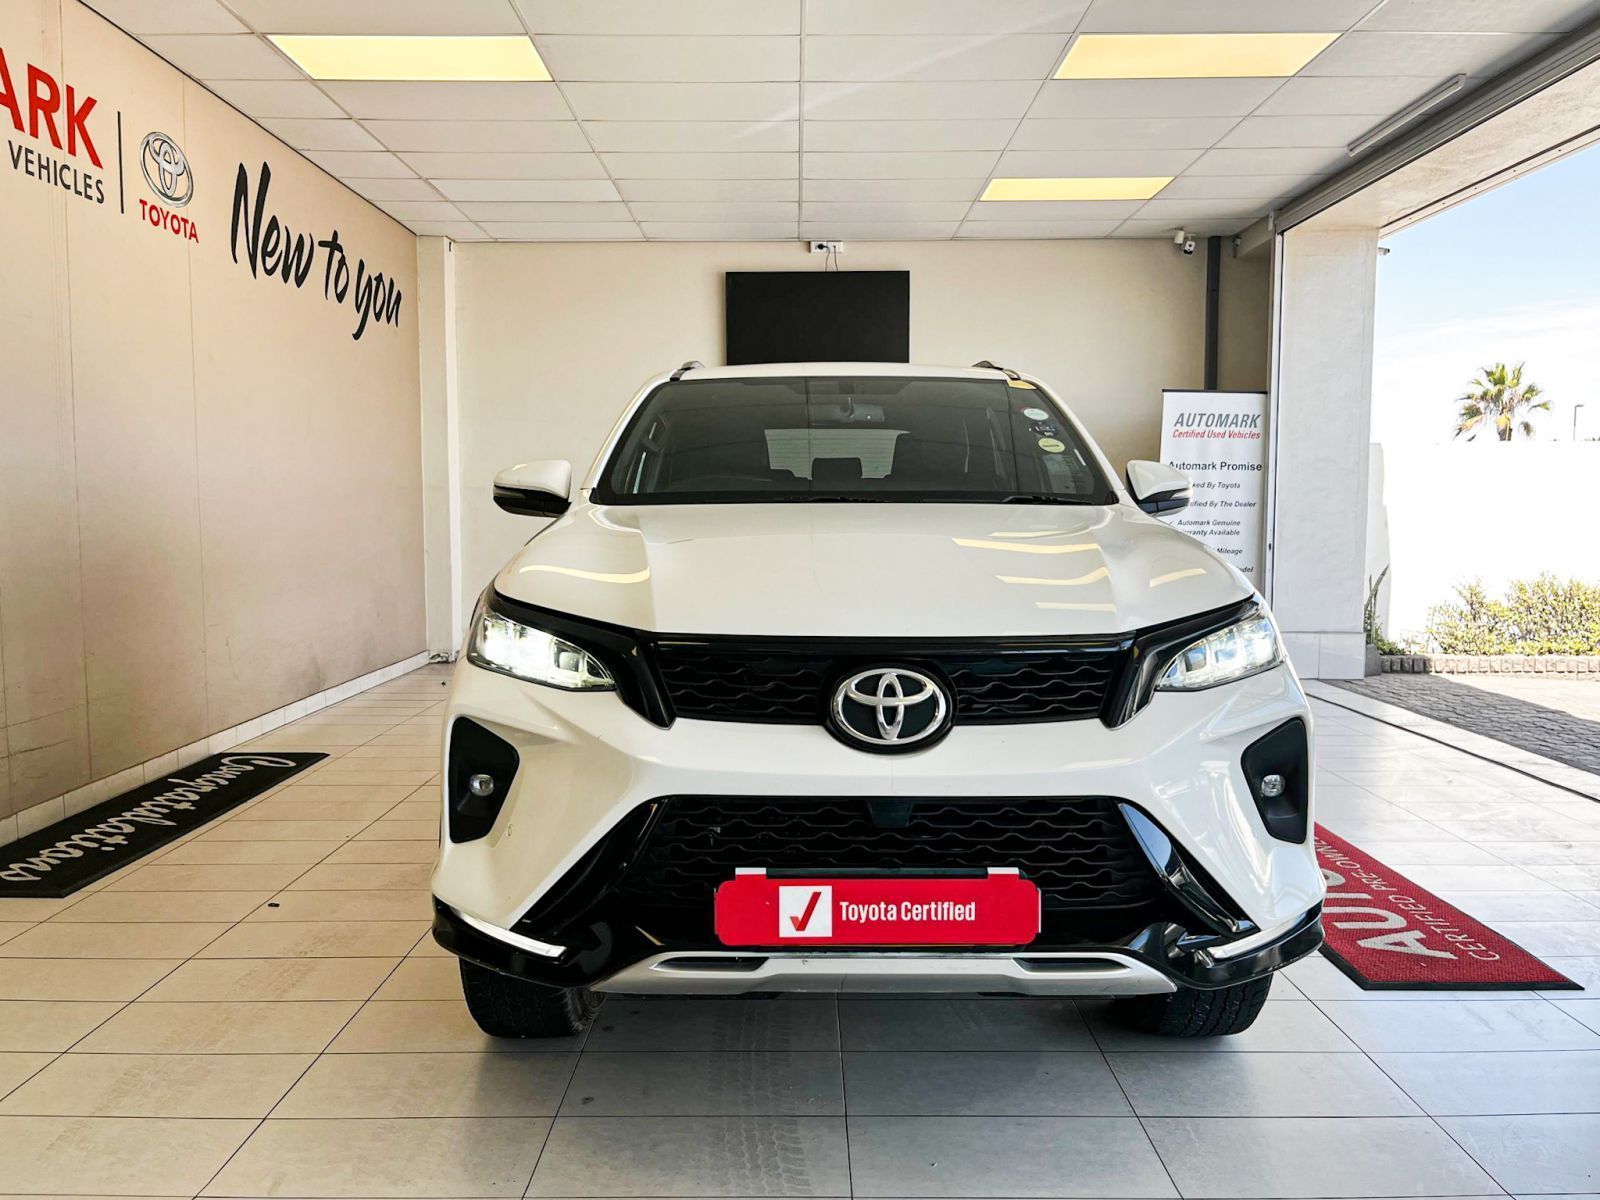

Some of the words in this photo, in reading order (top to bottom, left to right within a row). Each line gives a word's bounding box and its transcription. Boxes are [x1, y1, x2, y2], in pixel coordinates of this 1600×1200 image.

[8, 140, 105, 204] VEHICLES
[139, 199, 199, 244] TOYOTA
[230, 161, 314, 288] New
[318, 229, 350, 303] to
[351, 258, 402, 340] you
[1173, 412, 1261, 429] AUTOMARK
[1172, 429, 1206, 439] Certified
[1207, 430, 1227, 439] Used
[1228, 431, 1261, 440] Vehicles
[1220, 461, 1263, 472] Promise
[1206, 481, 1216, 490] By
[1217, 481, 1241, 490] Toyota
[1209, 500, 1218, 508] By
[1234, 500, 1257, 508] Dealer
[0, 755, 297, 881] Congratulations
[839, 901, 897, 923] Toyota
[900, 901, 976, 921] Certified
[1388, 894, 1501, 961] CERTIFIED
